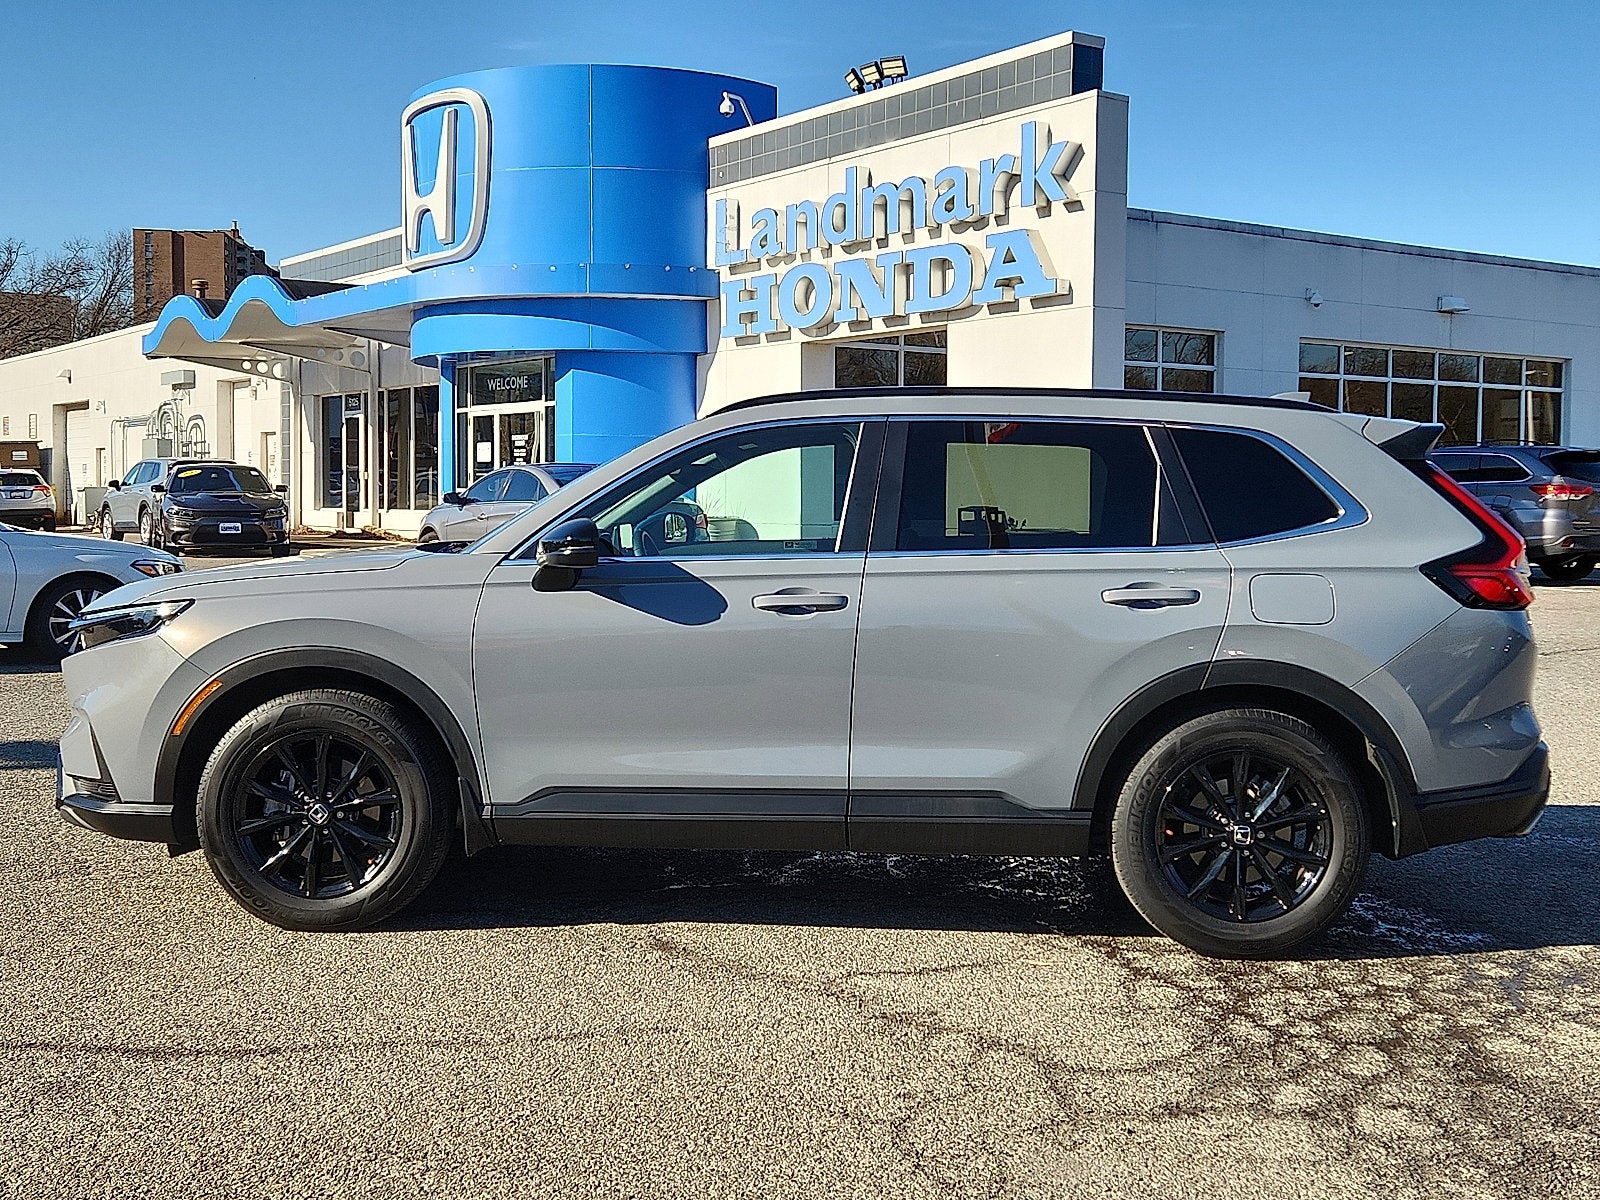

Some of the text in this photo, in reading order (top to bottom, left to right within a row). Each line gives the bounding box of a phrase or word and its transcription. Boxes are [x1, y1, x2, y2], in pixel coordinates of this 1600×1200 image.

[715, 121, 1070, 267] Landmark
[721, 228, 1058, 339] HONDA
[487, 375, 528, 391] WELCOME
